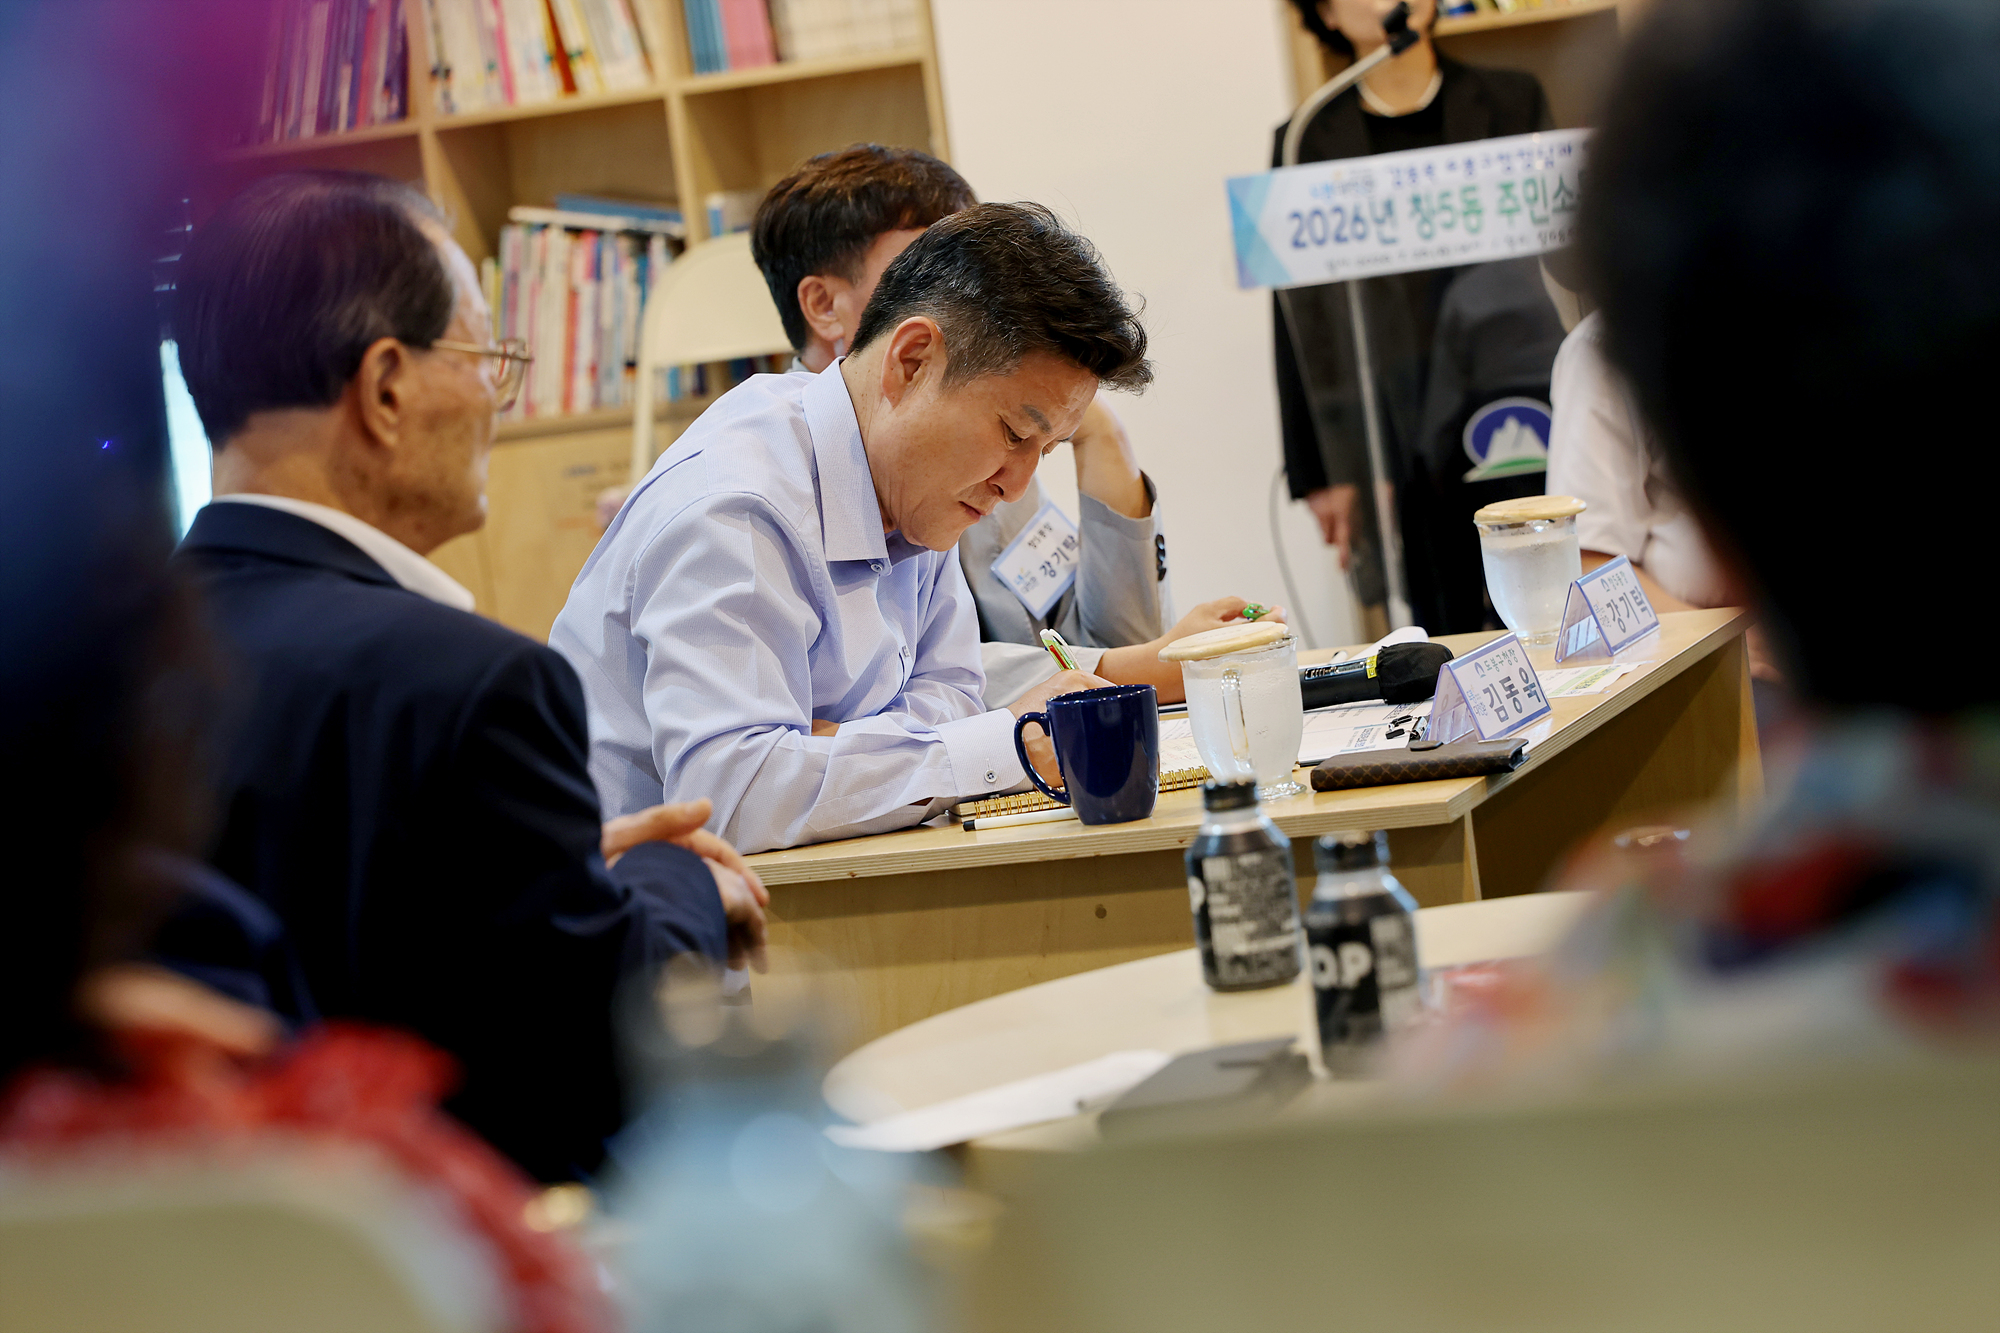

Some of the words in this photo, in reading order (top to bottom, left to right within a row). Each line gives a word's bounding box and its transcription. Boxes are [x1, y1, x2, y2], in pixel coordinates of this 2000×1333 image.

[1288, 196, 1399, 249] 2026년
[1410, 184, 1484, 240] 창5동
[1606, 586, 1652, 634] 강기탁
[1484, 648, 1519, 673] 도봉구청장
[1482, 667, 1541, 723] 김동욱
